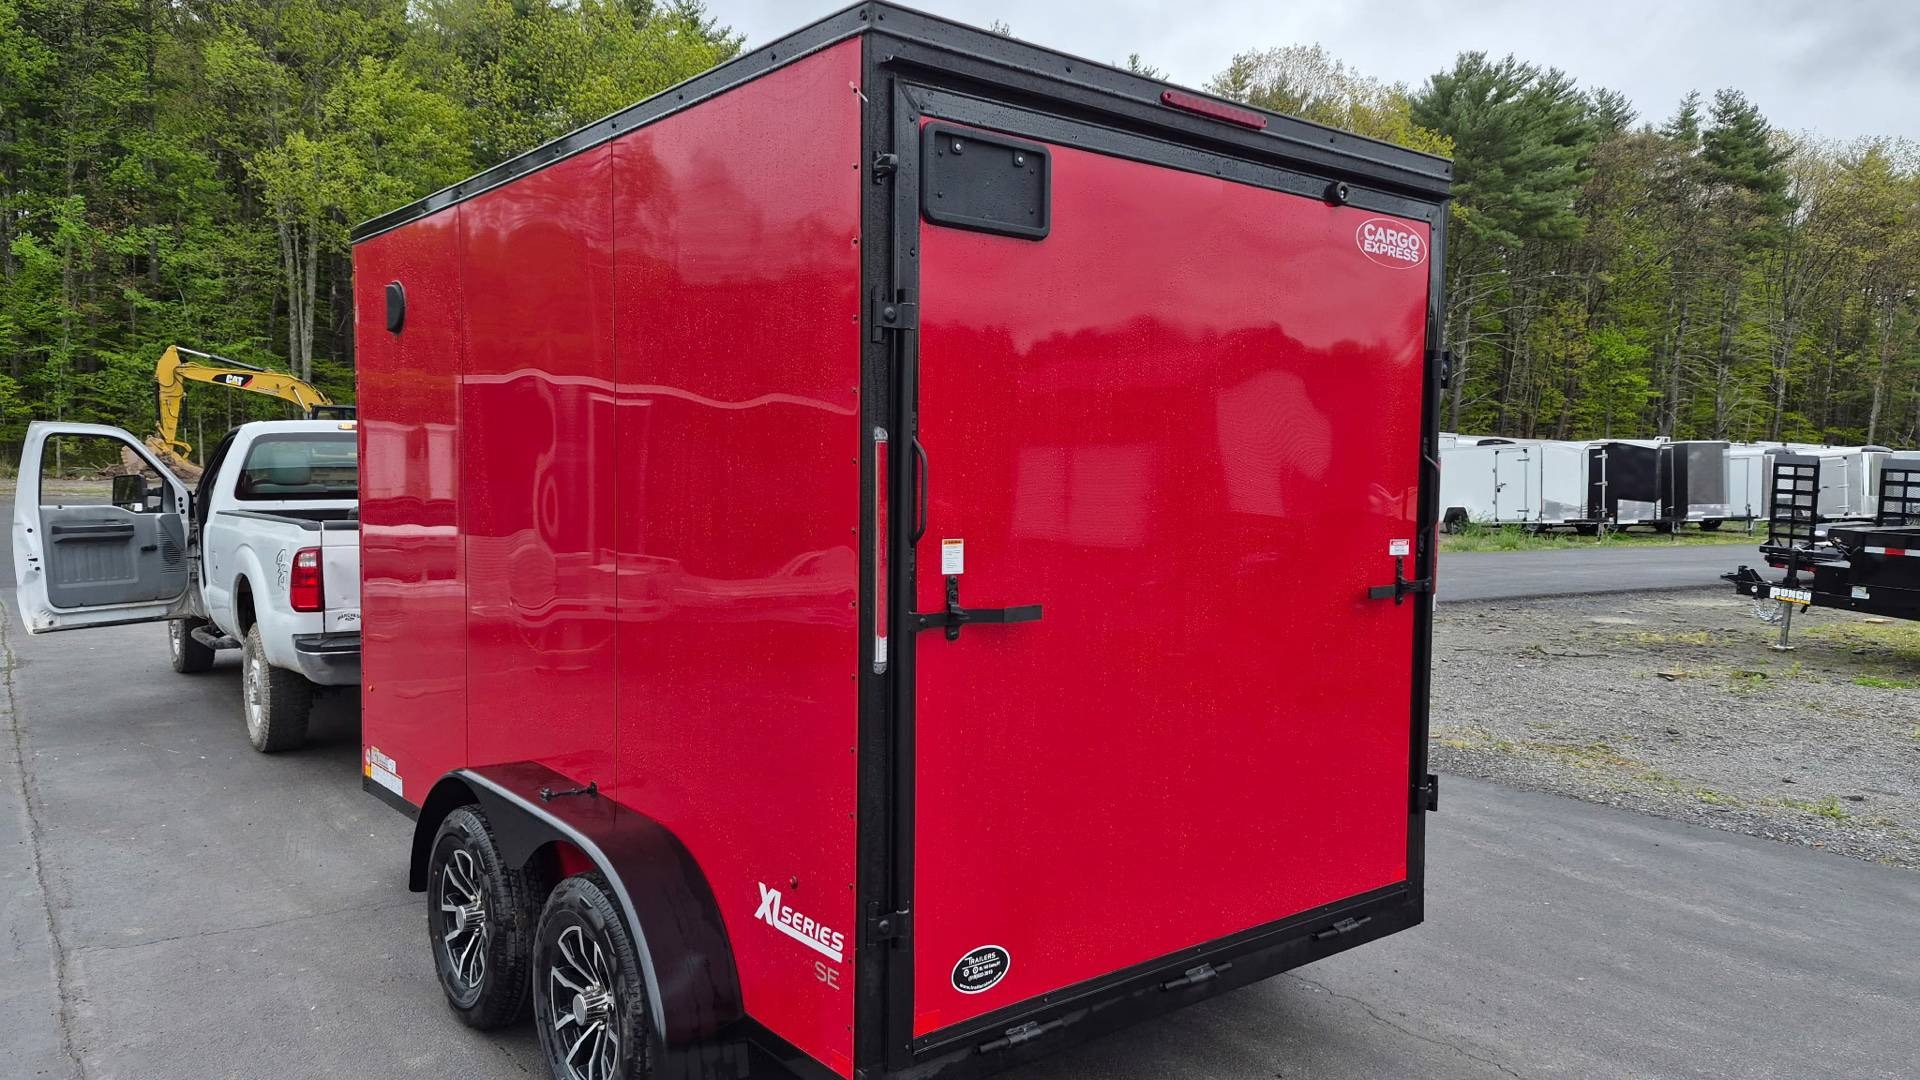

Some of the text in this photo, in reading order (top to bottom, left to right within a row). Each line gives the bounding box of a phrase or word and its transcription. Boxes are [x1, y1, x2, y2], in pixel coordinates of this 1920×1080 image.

[1363, 223, 1420, 251] CARGO
[1363, 240, 1419, 263] EXPRESS
[225, 374, 244, 387] CAT
[780, 905, 845, 952] SERIES
[814, 960, 840, 991] SE
